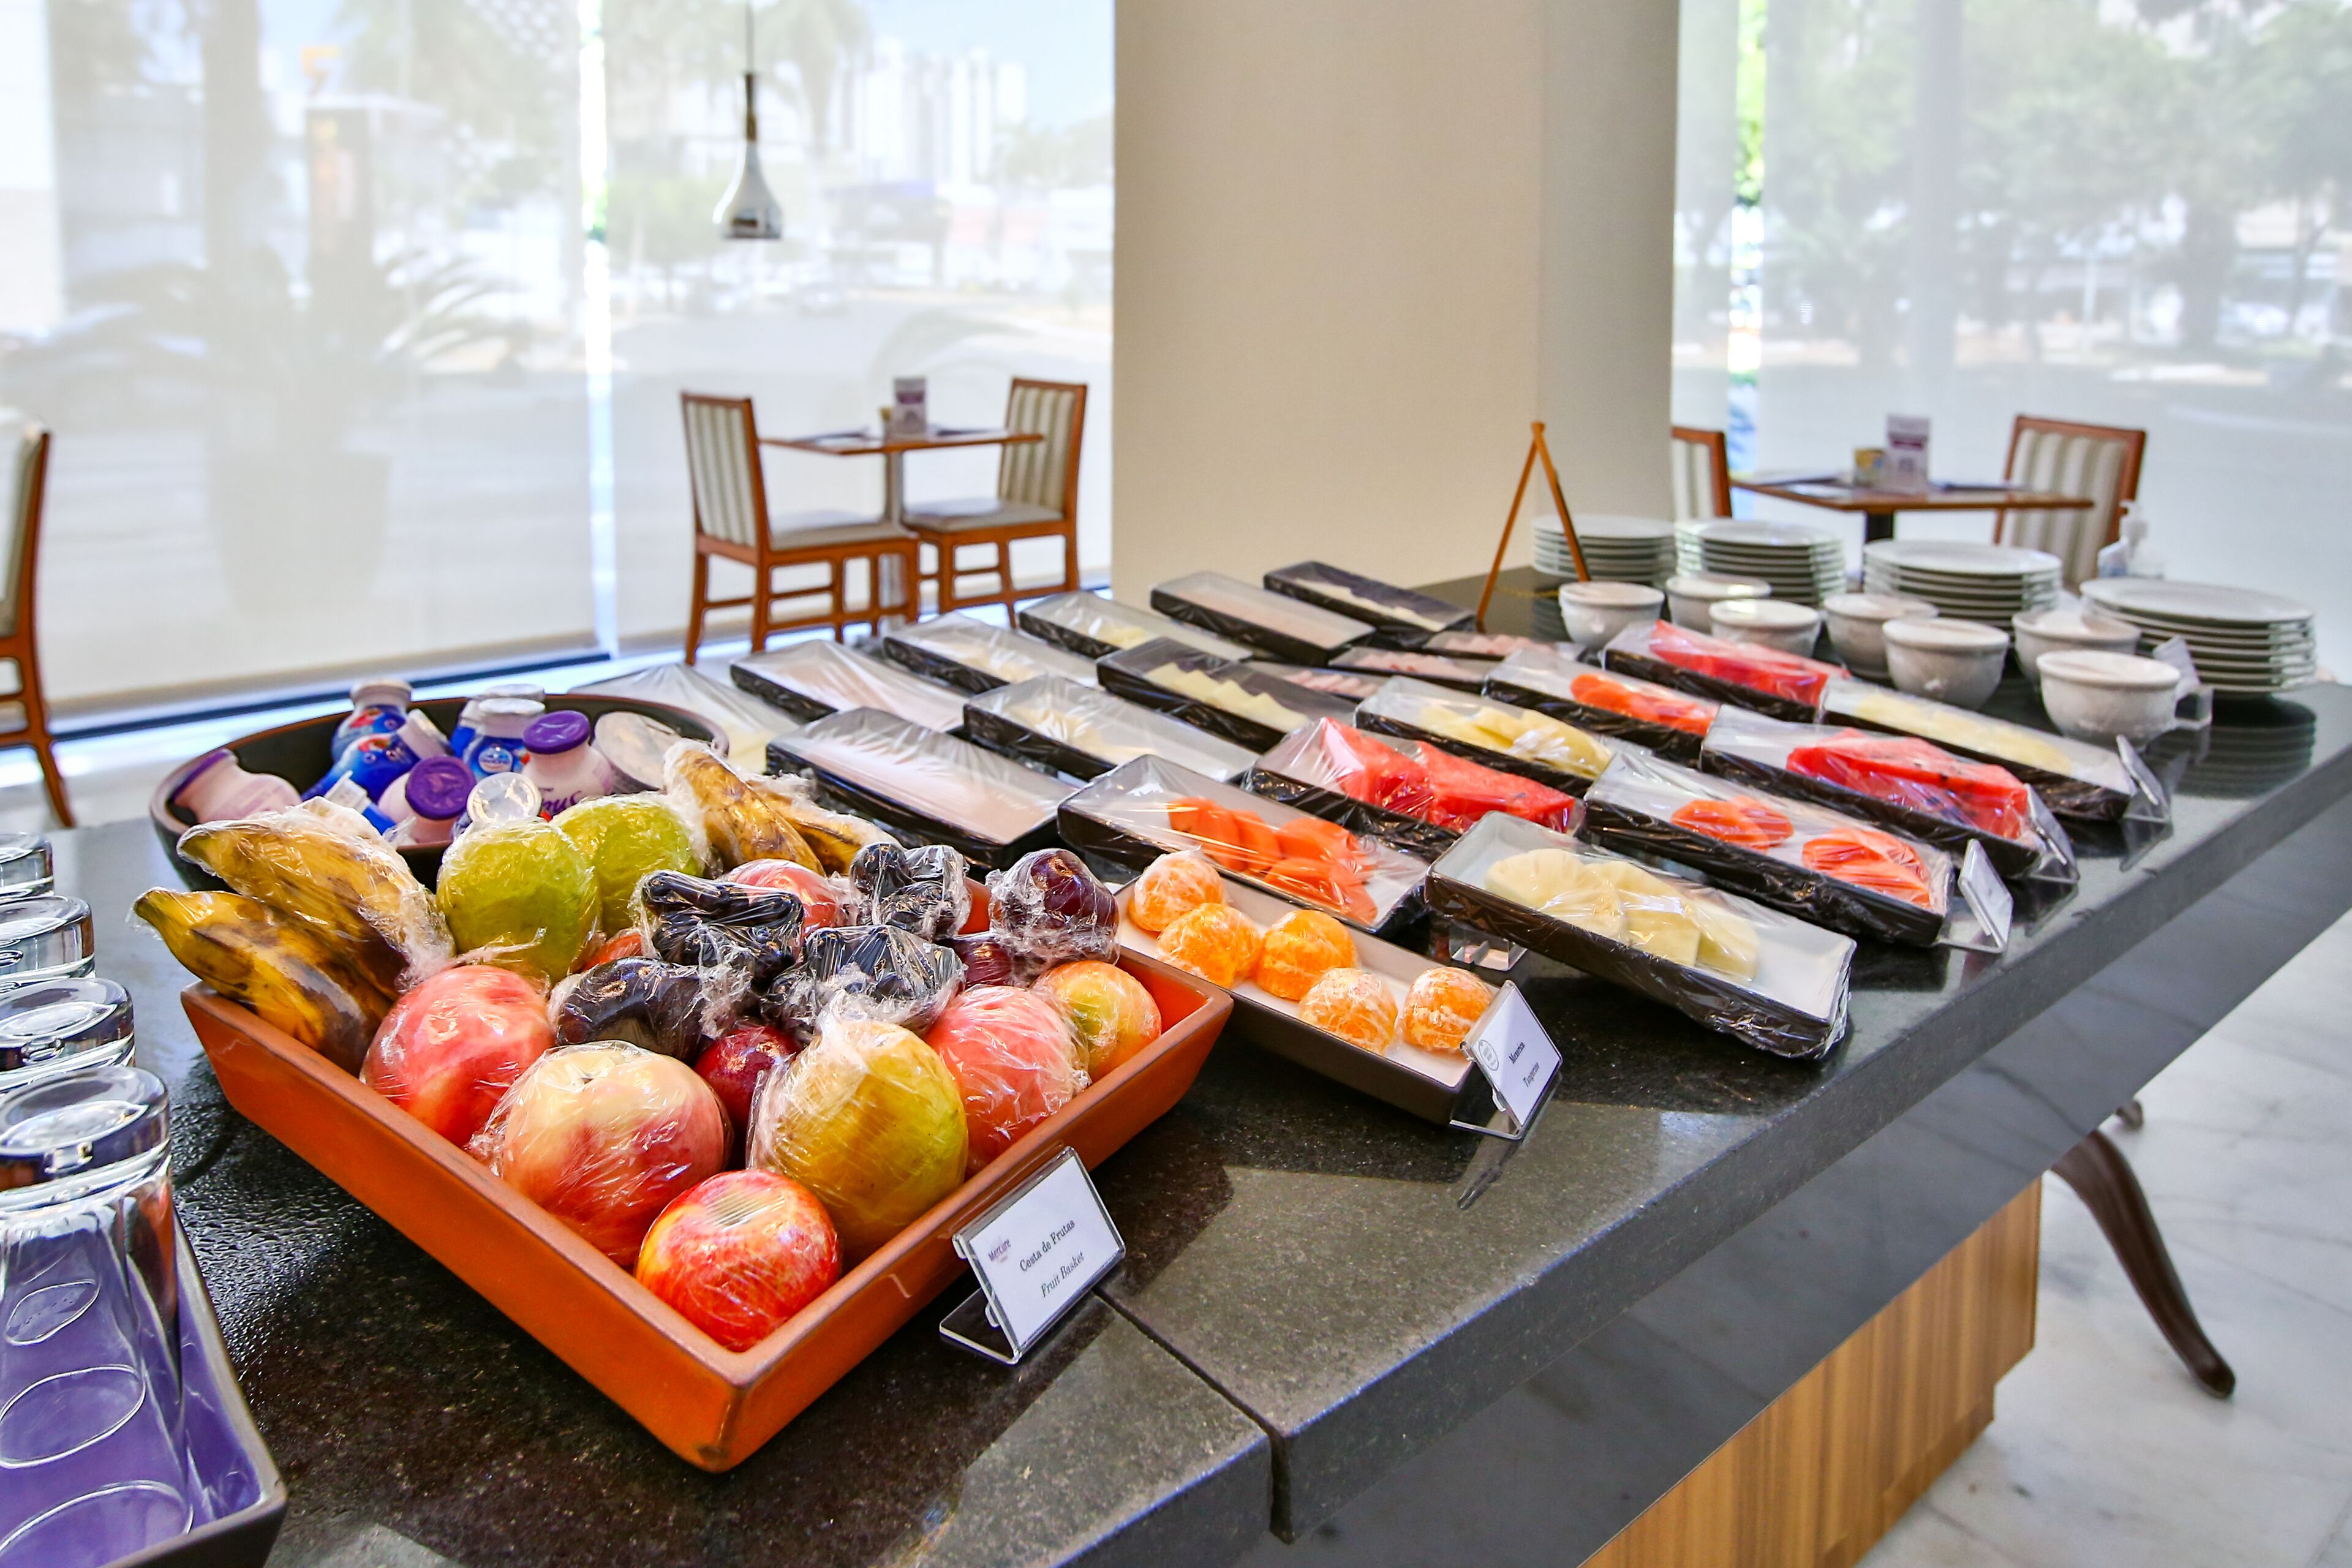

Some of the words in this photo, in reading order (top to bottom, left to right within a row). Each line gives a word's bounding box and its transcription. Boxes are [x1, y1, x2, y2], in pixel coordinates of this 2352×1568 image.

[988, 1238, 1011, 1262] Mercure
[1020, 1251, 1042, 1272] Cesta
[1042, 1241, 1052, 1253] de
[1050, 1220, 1076, 1245] Frutas
[1041, 1273, 1060, 1298] Fruit
[1060, 1251, 1085, 1280] Basket
